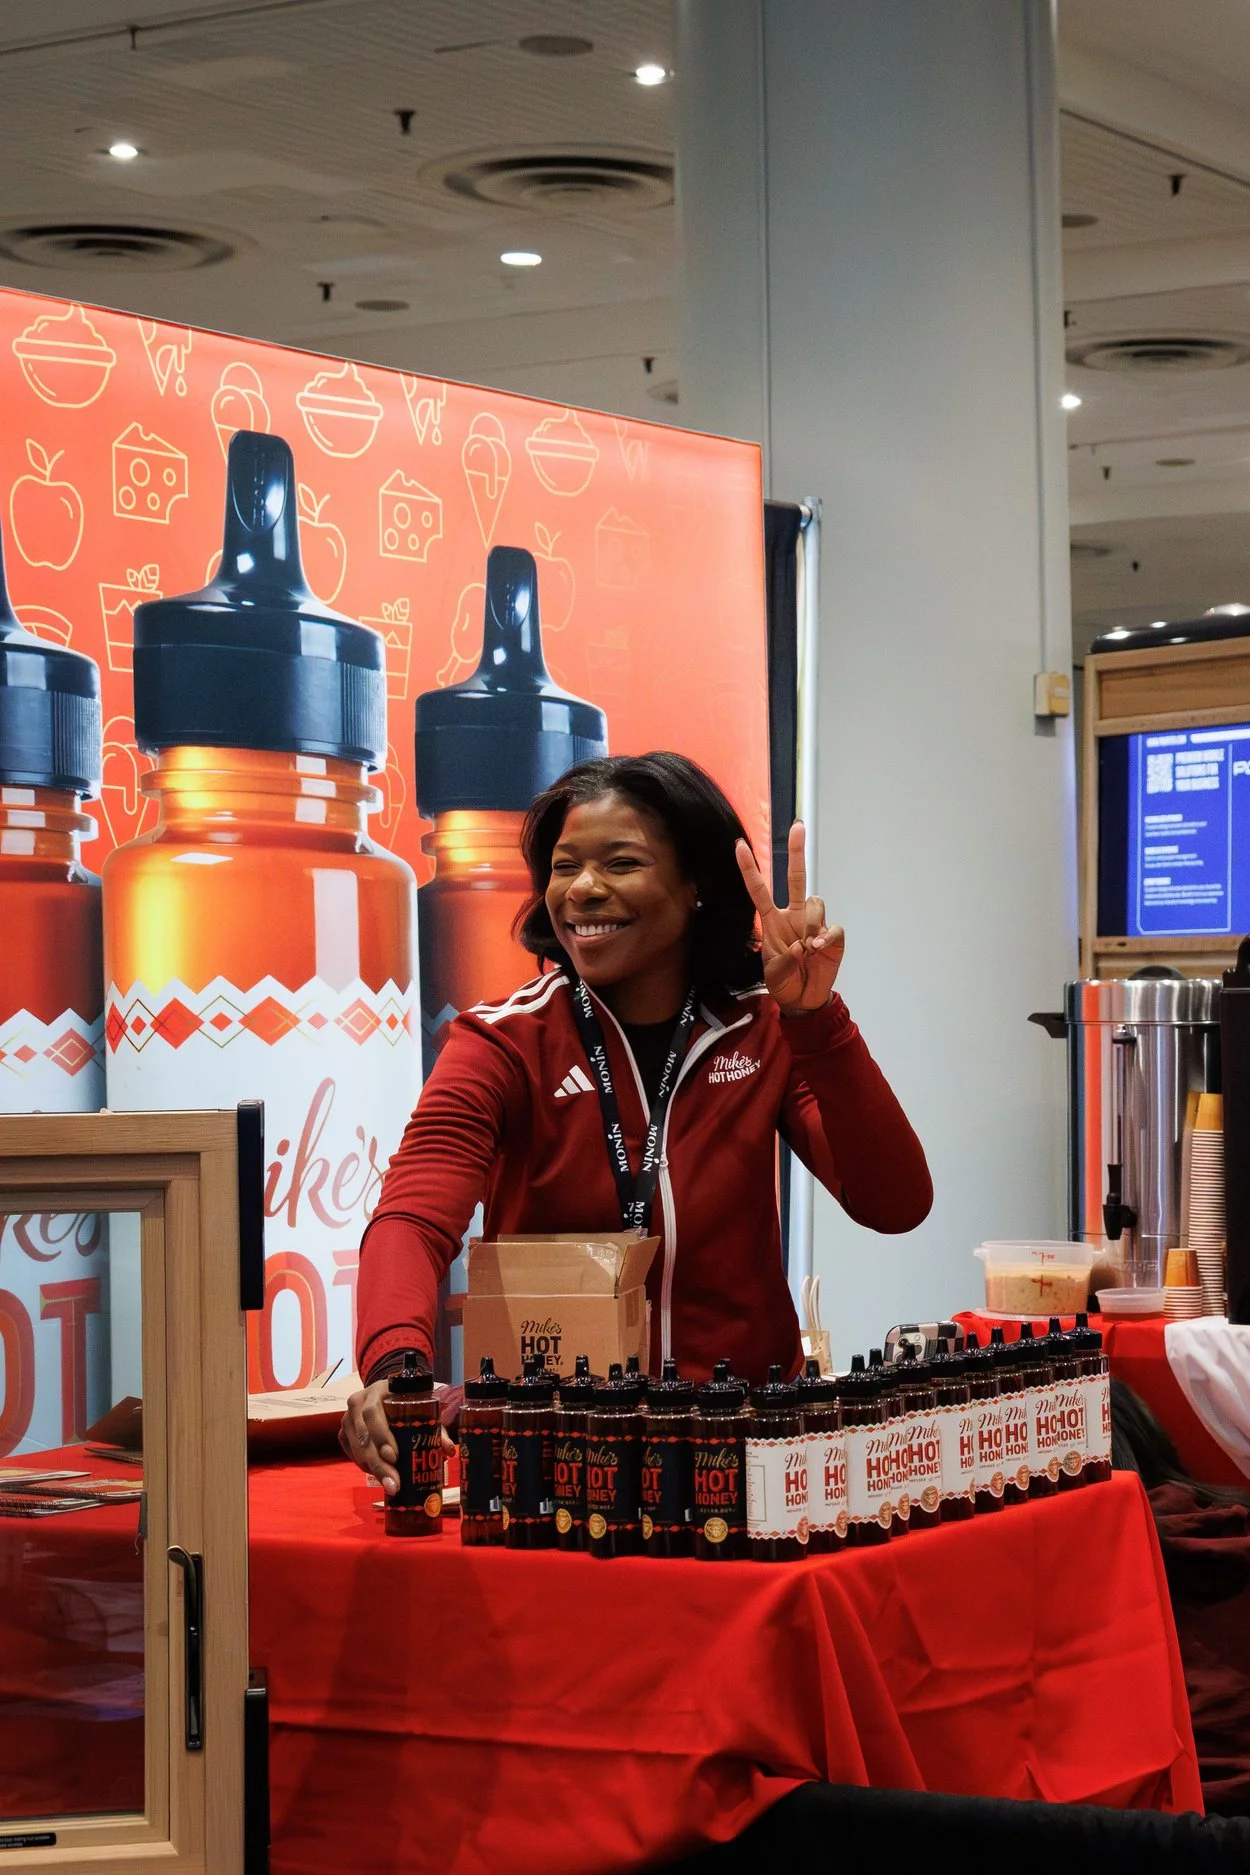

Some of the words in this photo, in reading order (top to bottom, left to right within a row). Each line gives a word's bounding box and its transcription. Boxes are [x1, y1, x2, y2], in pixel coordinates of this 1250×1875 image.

[708, 1071, 725, 1083] HOT
[726, 1059, 761, 1082] HONEY
[713, 1051, 752, 1072] Mike's
[264, 1077, 386, 1228] ike's
[608, 1122, 629, 1172] MONIN
[642, 1123, 661, 1173] MONIN
[521, 1318, 562, 1334] Mike's
[521, 1336, 561, 1354] HOT
[1005, 1420, 1028, 1444] HO
[1036, 1414, 1057, 1436] HO
[978, 1427, 1002, 1450] HO
[412, 1450, 443, 1471] HO
[866, 1454, 890, 1479] HO
[889, 1446, 908, 1471] HO
[908, 1461, 940, 1476] HONE
[642, 1468, 662, 1490] OT
[695, 1468, 738, 1491] HOT
[785, 1469, 808, 1493] HO
[824, 1463, 847, 1486] HO
[695, 1491, 738, 1504] HONEY
